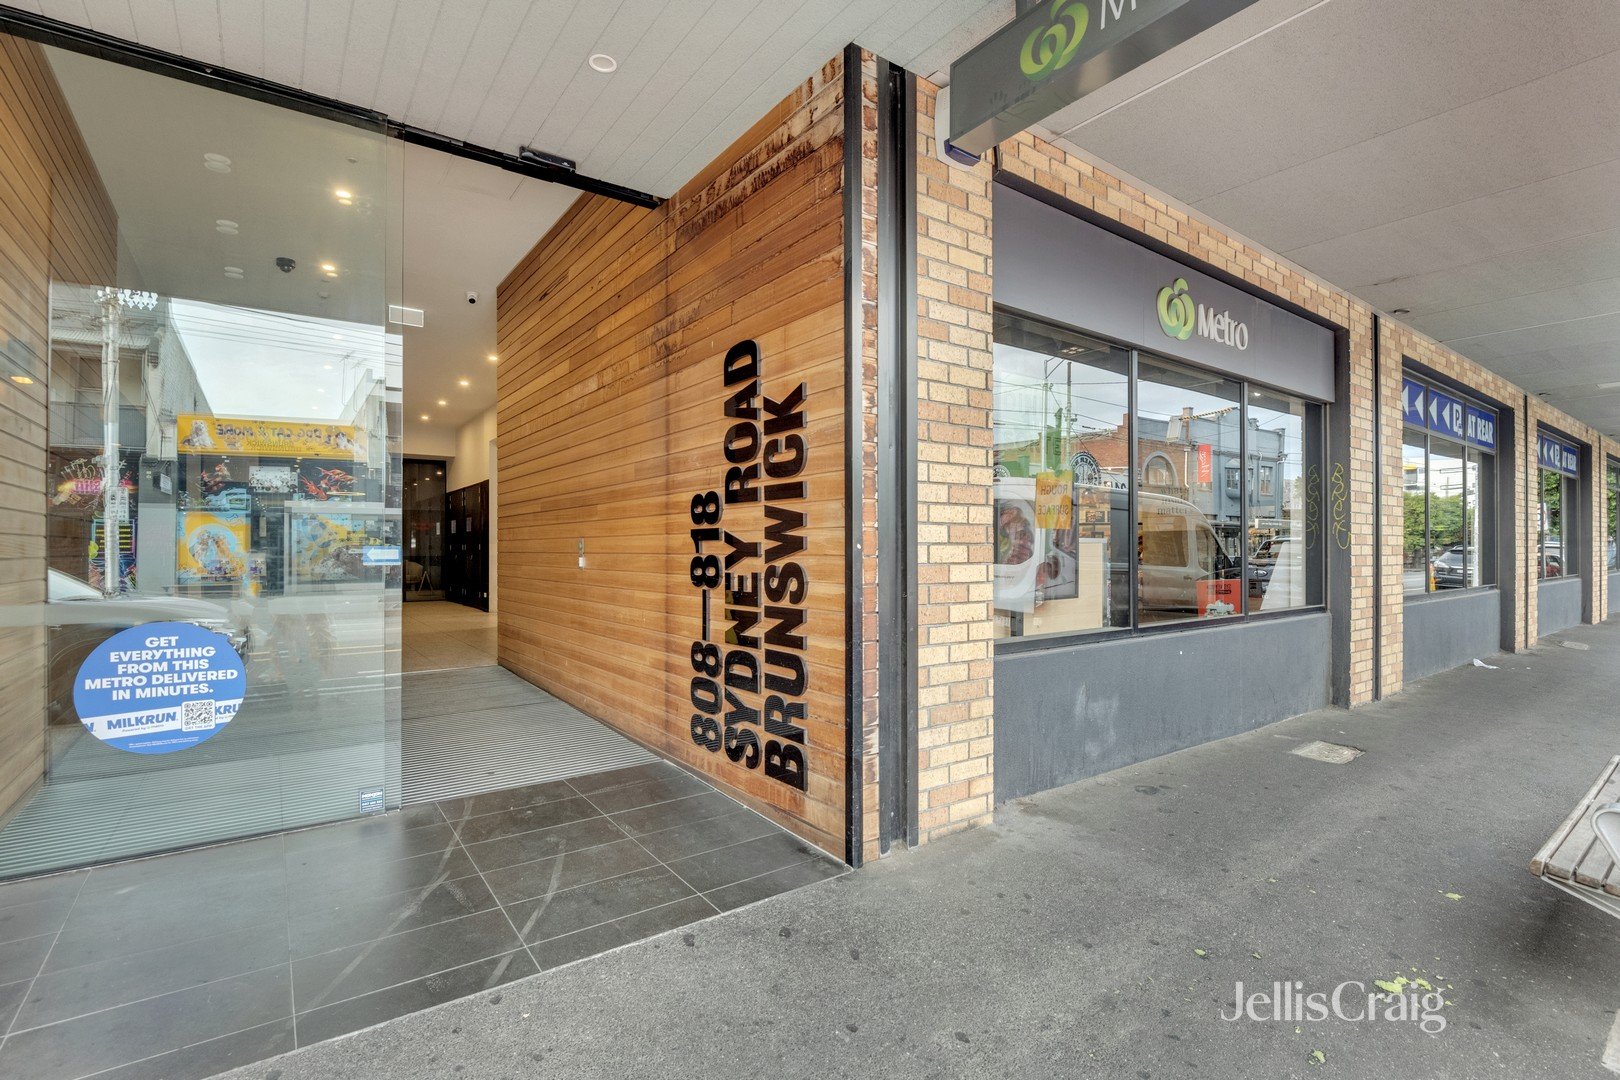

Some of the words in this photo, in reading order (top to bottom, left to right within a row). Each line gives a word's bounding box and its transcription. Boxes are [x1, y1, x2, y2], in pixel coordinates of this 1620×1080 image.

[1197, 304, 1248, 350] Metro
[724, 339, 762, 504] ROAD
[1467, 414, 1477, 437] AT
[1477, 418, 1494, 444] REAR
[763, 382, 809, 792] BRUNSWICK
[145, 636, 179, 648] GET
[724, 530, 762, 769] SYDNEY
[109, 646, 216, 663] EVERYTHING
[117, 662, 168, 675] FROM
[172, 659, 210, 671] THIS
[84, 675, 147, 690] METRO
[151, 669, 239, 685] DELIVERED
[112, 689, 131, 700] IN
[135, 683, 214, 699] MINUTES.
[107, 711, 177, 730] MILKRUN
